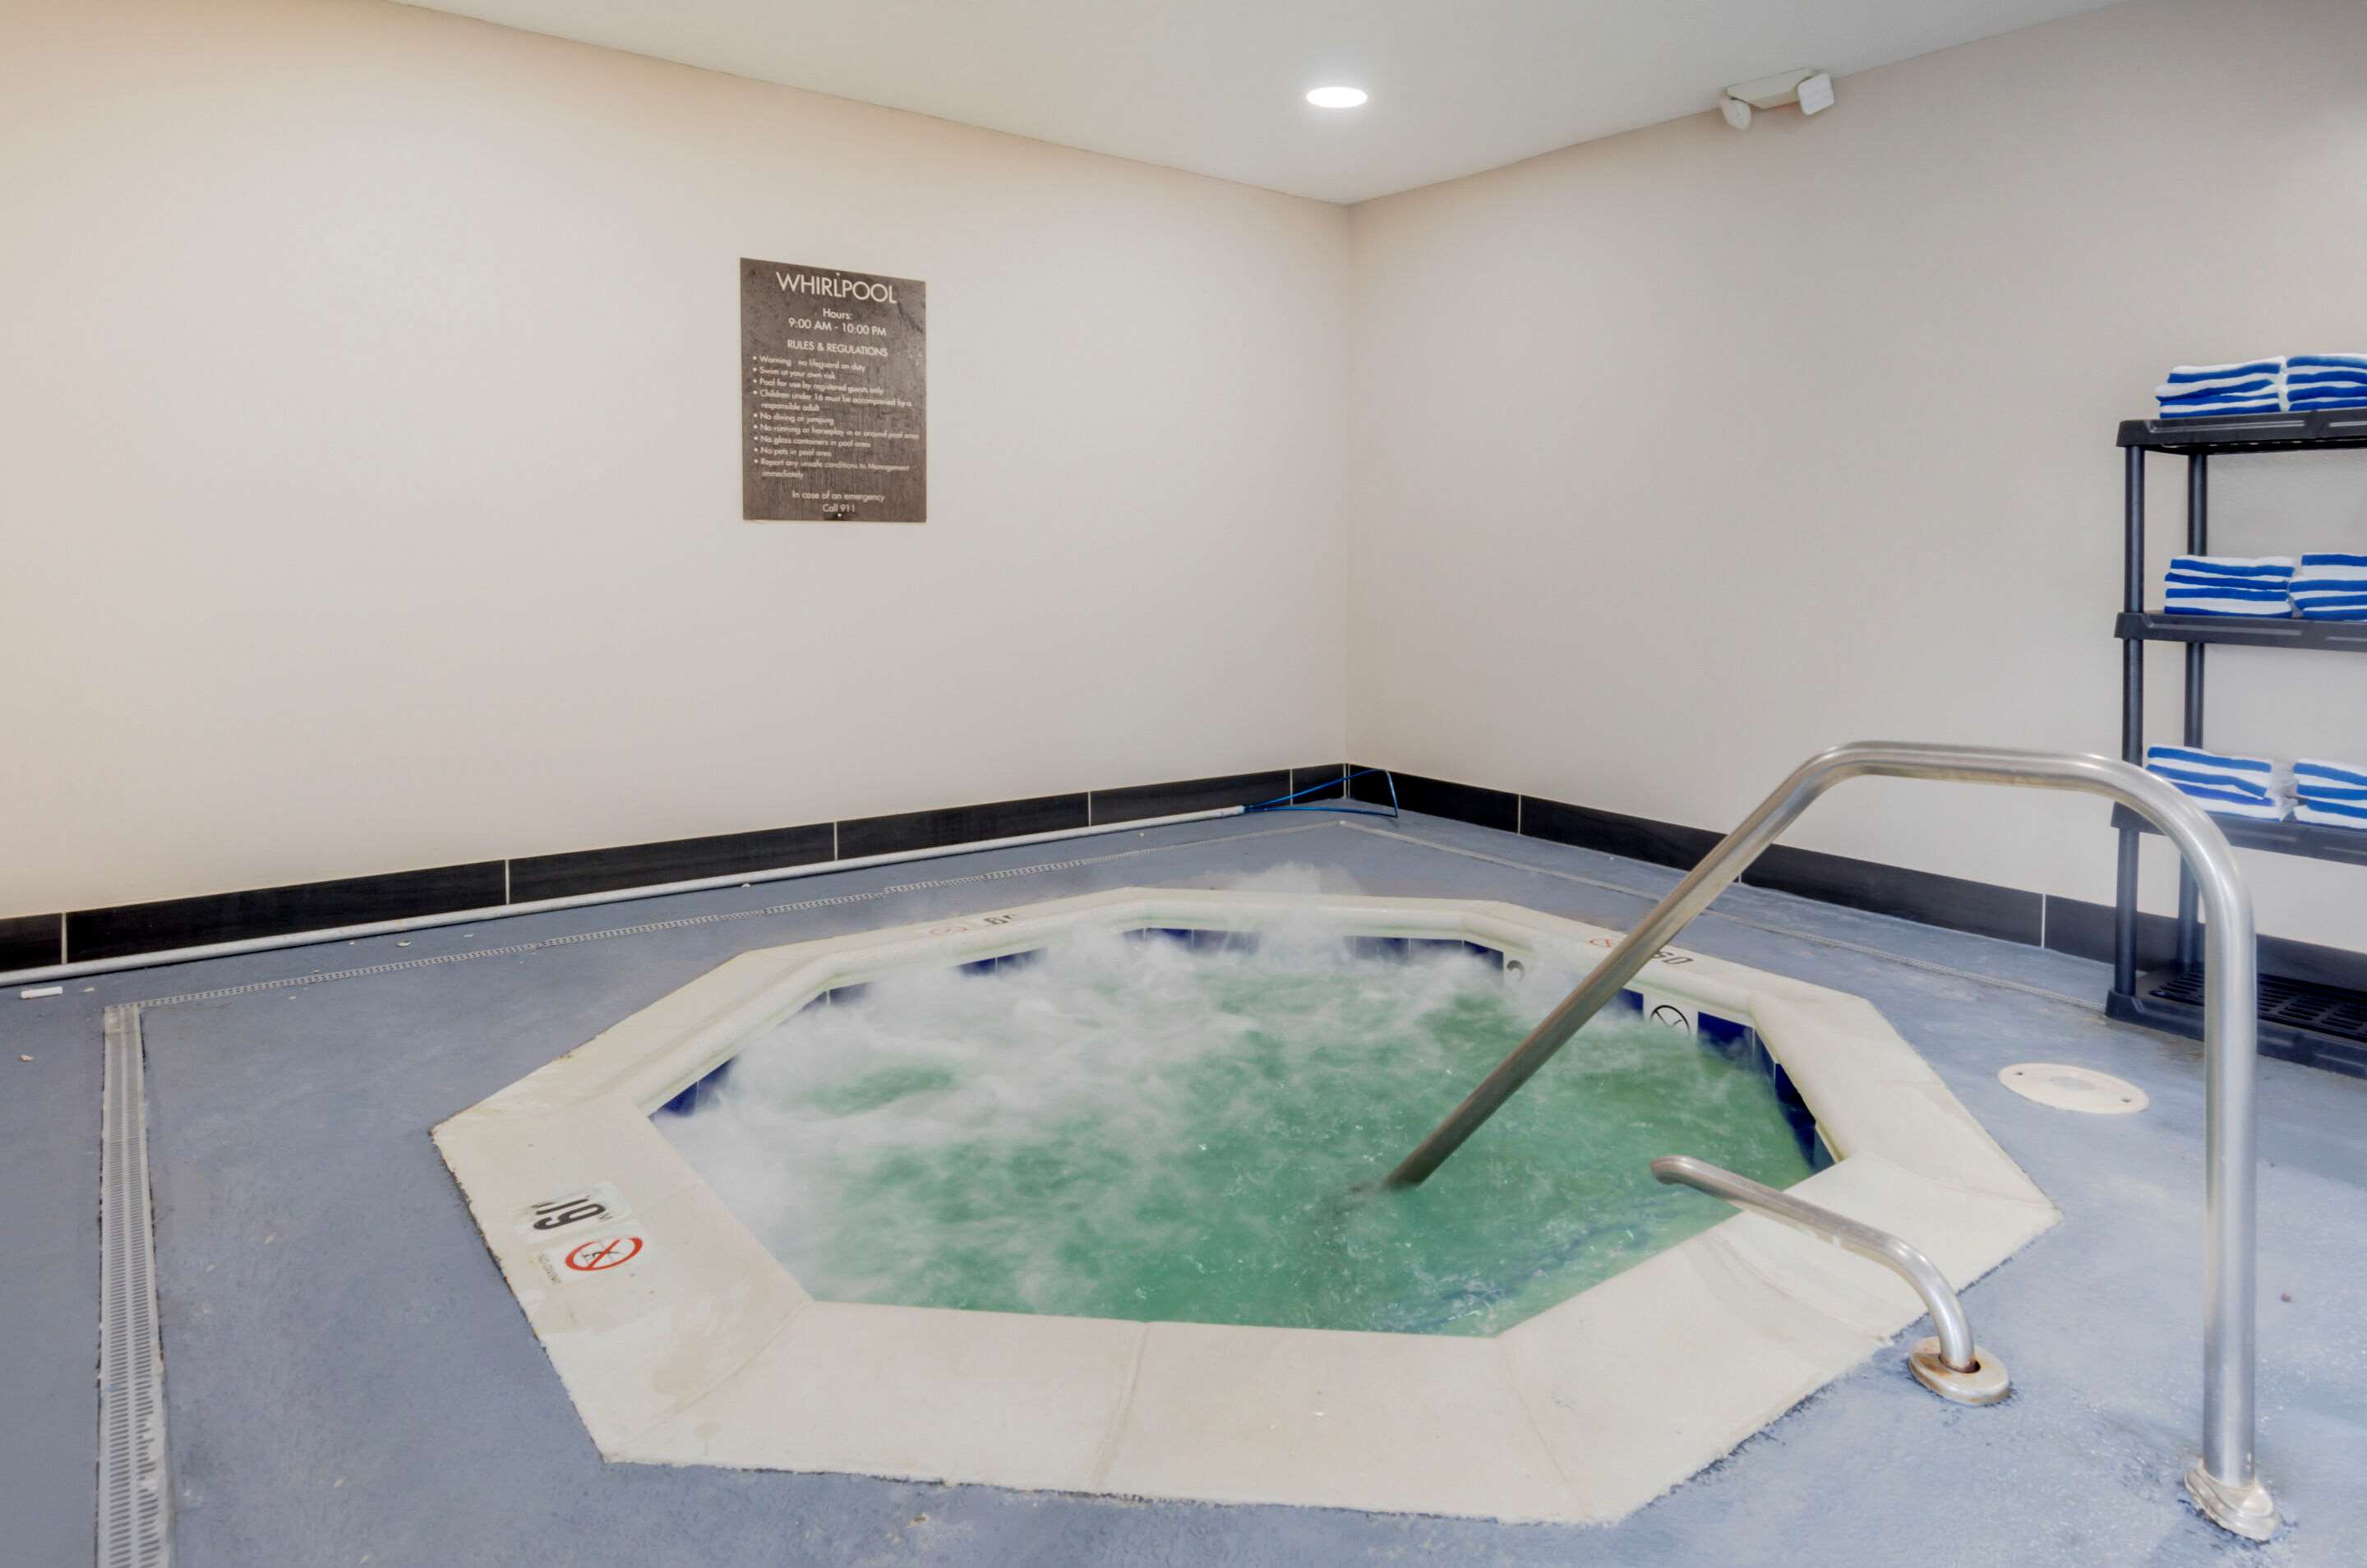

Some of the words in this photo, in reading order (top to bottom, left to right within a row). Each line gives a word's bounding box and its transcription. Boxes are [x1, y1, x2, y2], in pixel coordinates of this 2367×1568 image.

[775, 271, 897, 304] WHIRLPOOL
[823, 307, 853, 320] Hours:
[788, 317, 812, 329] 9:00
[814, 320, 832, 331] AM
[842, 322, 870, 334] 10:00
[871, 325, 887, 335] PM
[787, 339, 814, 350] RULES
[817, 342, 824, 351] &
[827, 343, 888, 357] REGULATIONS
[759, 355, 791, 367] Warning
[809, 358, 840, 369] lifeguard
[851, 362, 866, 372] duty
[759, 366, 780, 375] Swim
[824, 371, 836, 379] risk
[759, 377, 775, 386] Pool
[777, 378, 787, 387] for
[802, 380, 812, 390] by
[814, 383, 847, 392] registered
[870, 385, 884, 395] only
[759, 389, 790, 399] Children
[791, 392, 812, 400] under
[814, 393, 824, 401] 16
[842, 394, 851, 403] be
[897, 398, 906, 408] by
[801, 403, 820, 411] adult
[773, 413, 796, 423] diving
[773, 427, 801, 435] running
[811, 425, 844, 436] horseplay
[760, 435, 772, 443] No
[773, 435, 791, 445] glass
[760, 446, 773, 454] No
[798, 448, 814, 457] pool
[760, 458, 784, 467] Report
[801, 459, 824, 468] unsafe
[824, 461, 859, 469] conditions
[867, 463, 910, 473] Management
[762, 469, 804, 479] immediately
[791, 490, 801, 498] In
[821, 490, 830, 499] of
[843, 494, 885, 502] emergency
[822, 504, 838, 512] Call
[840, 504, 856, 513] 911
